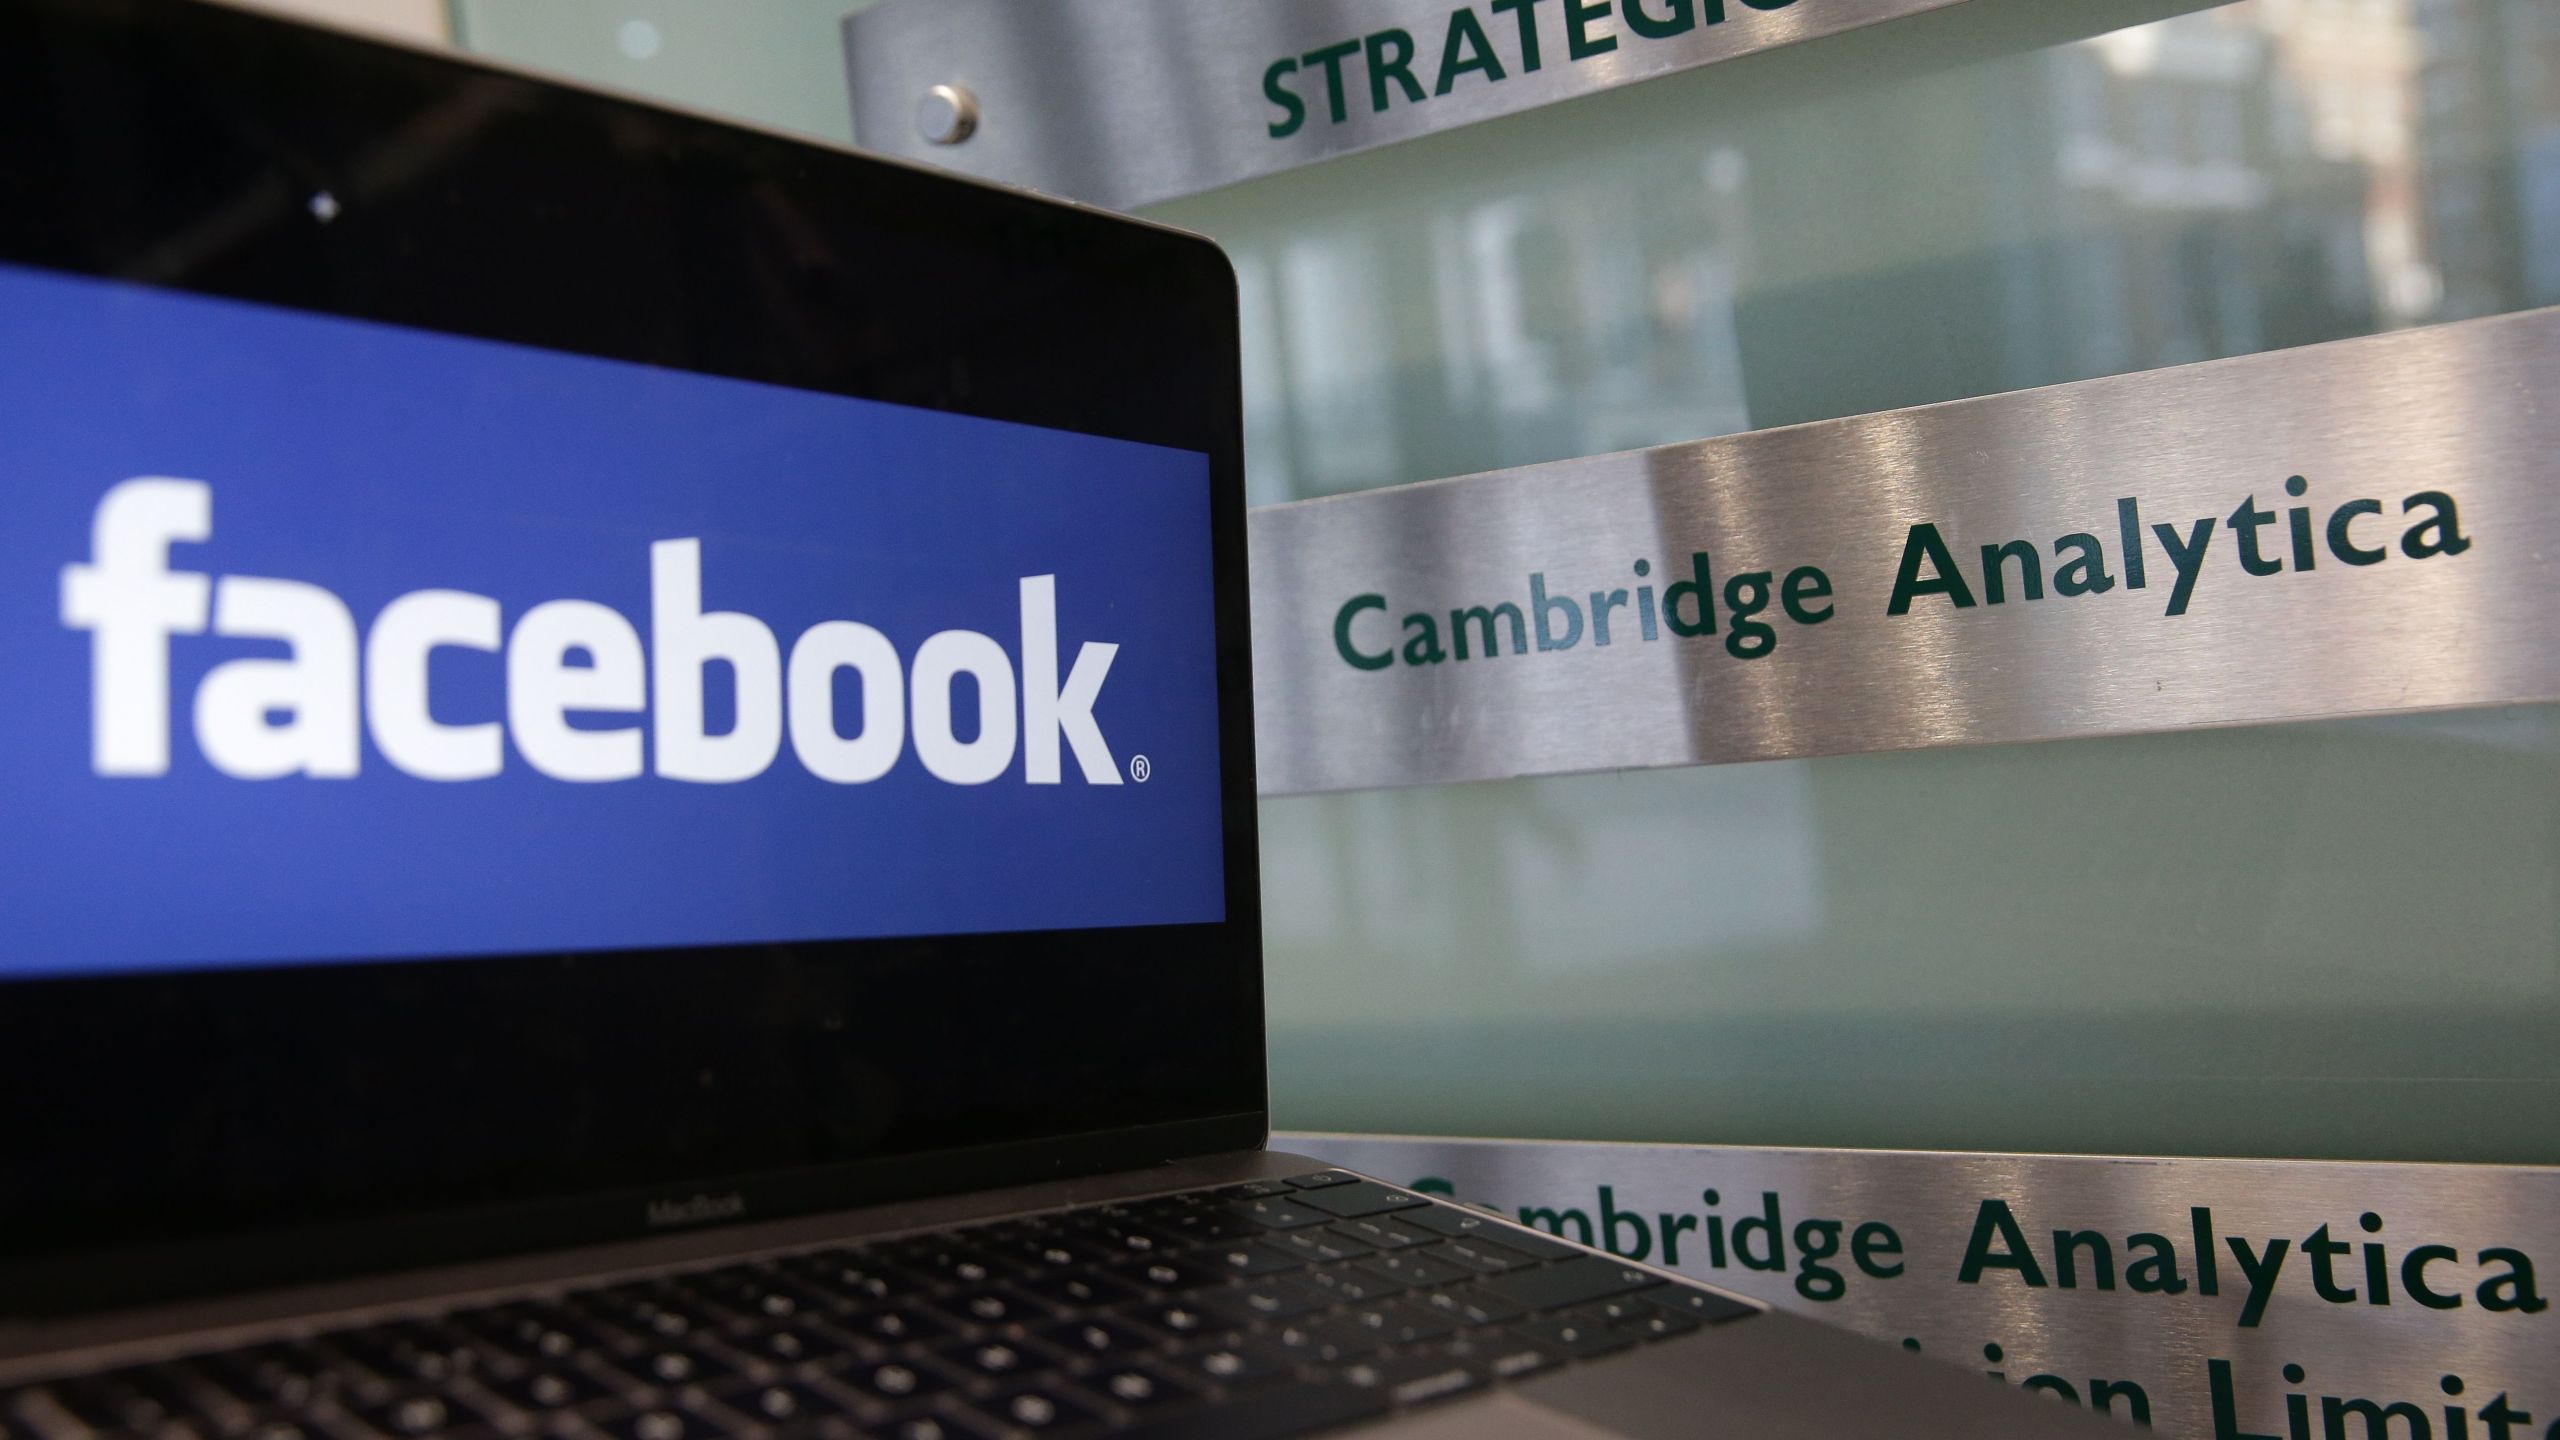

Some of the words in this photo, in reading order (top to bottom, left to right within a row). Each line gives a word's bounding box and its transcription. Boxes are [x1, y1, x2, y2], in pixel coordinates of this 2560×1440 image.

[60, 476, 1125, 785] facebook
[1333, 551, 1835, 671] Cambridge
[1886, 474, 2471, 617] Analytica
[1407, 1176, 1905, 1301] mbridge
[1957, 1199, 2548, 1328] Analytica
[2207, 1358, 2560, 1440] Limit
